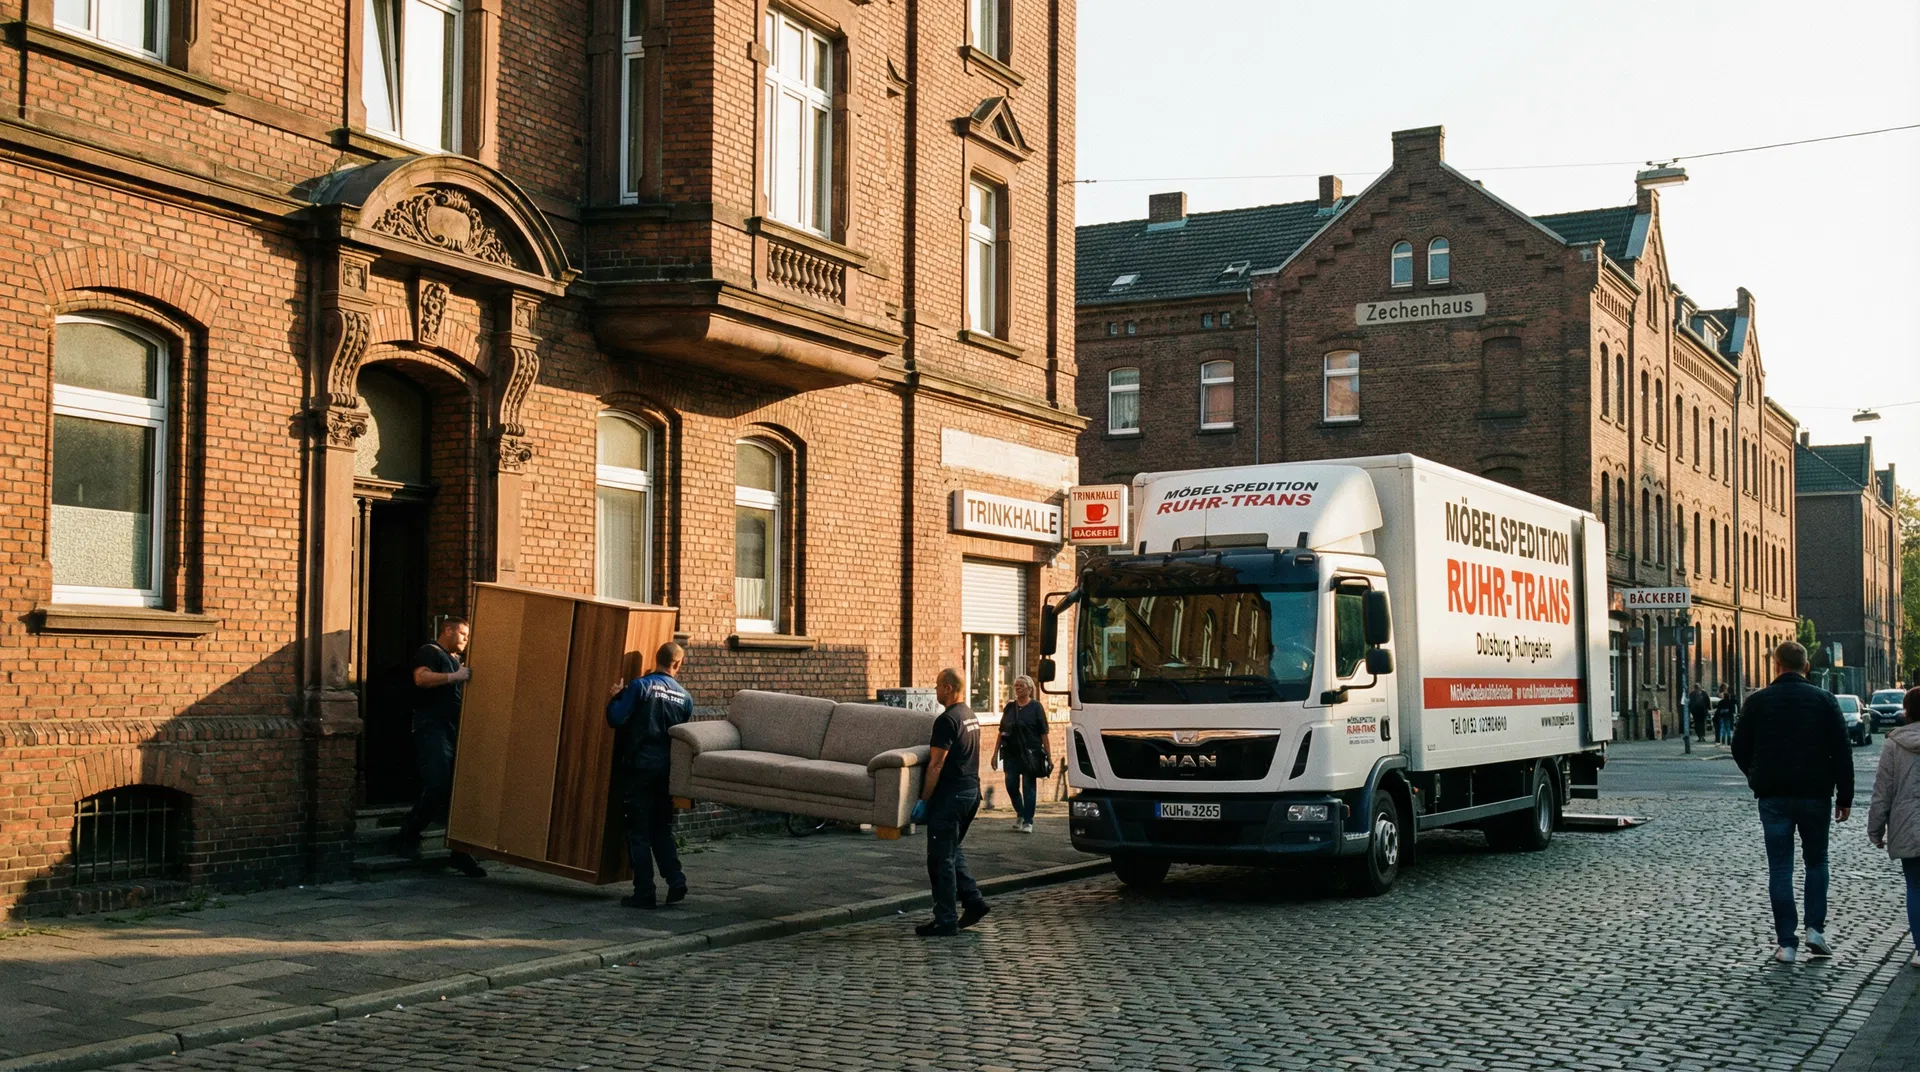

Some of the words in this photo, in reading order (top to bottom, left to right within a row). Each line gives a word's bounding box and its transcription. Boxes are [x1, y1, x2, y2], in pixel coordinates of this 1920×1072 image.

[1366, 299, 1473, 321] Zechenhaus
[1073, 490, 1119, 501] TRINKHALLE
[1164, 481, 1319, 500] MÖBELSPEDITION
[1156, 493, 1312, 515] RUHR-TRANS
[967, 499, 1057, 535] TRINKHALLE
[1445, 496, 1569, 566] MÖBELSPEDITION
[1447, 558, 1571, 625] RUHR-TRANS
[1629, 590, 1686, 604] BÄCKEREI
[1514, 635, 1552, 664] Ruhrgebiet
[1160, 755, 1217, 767] MAN
